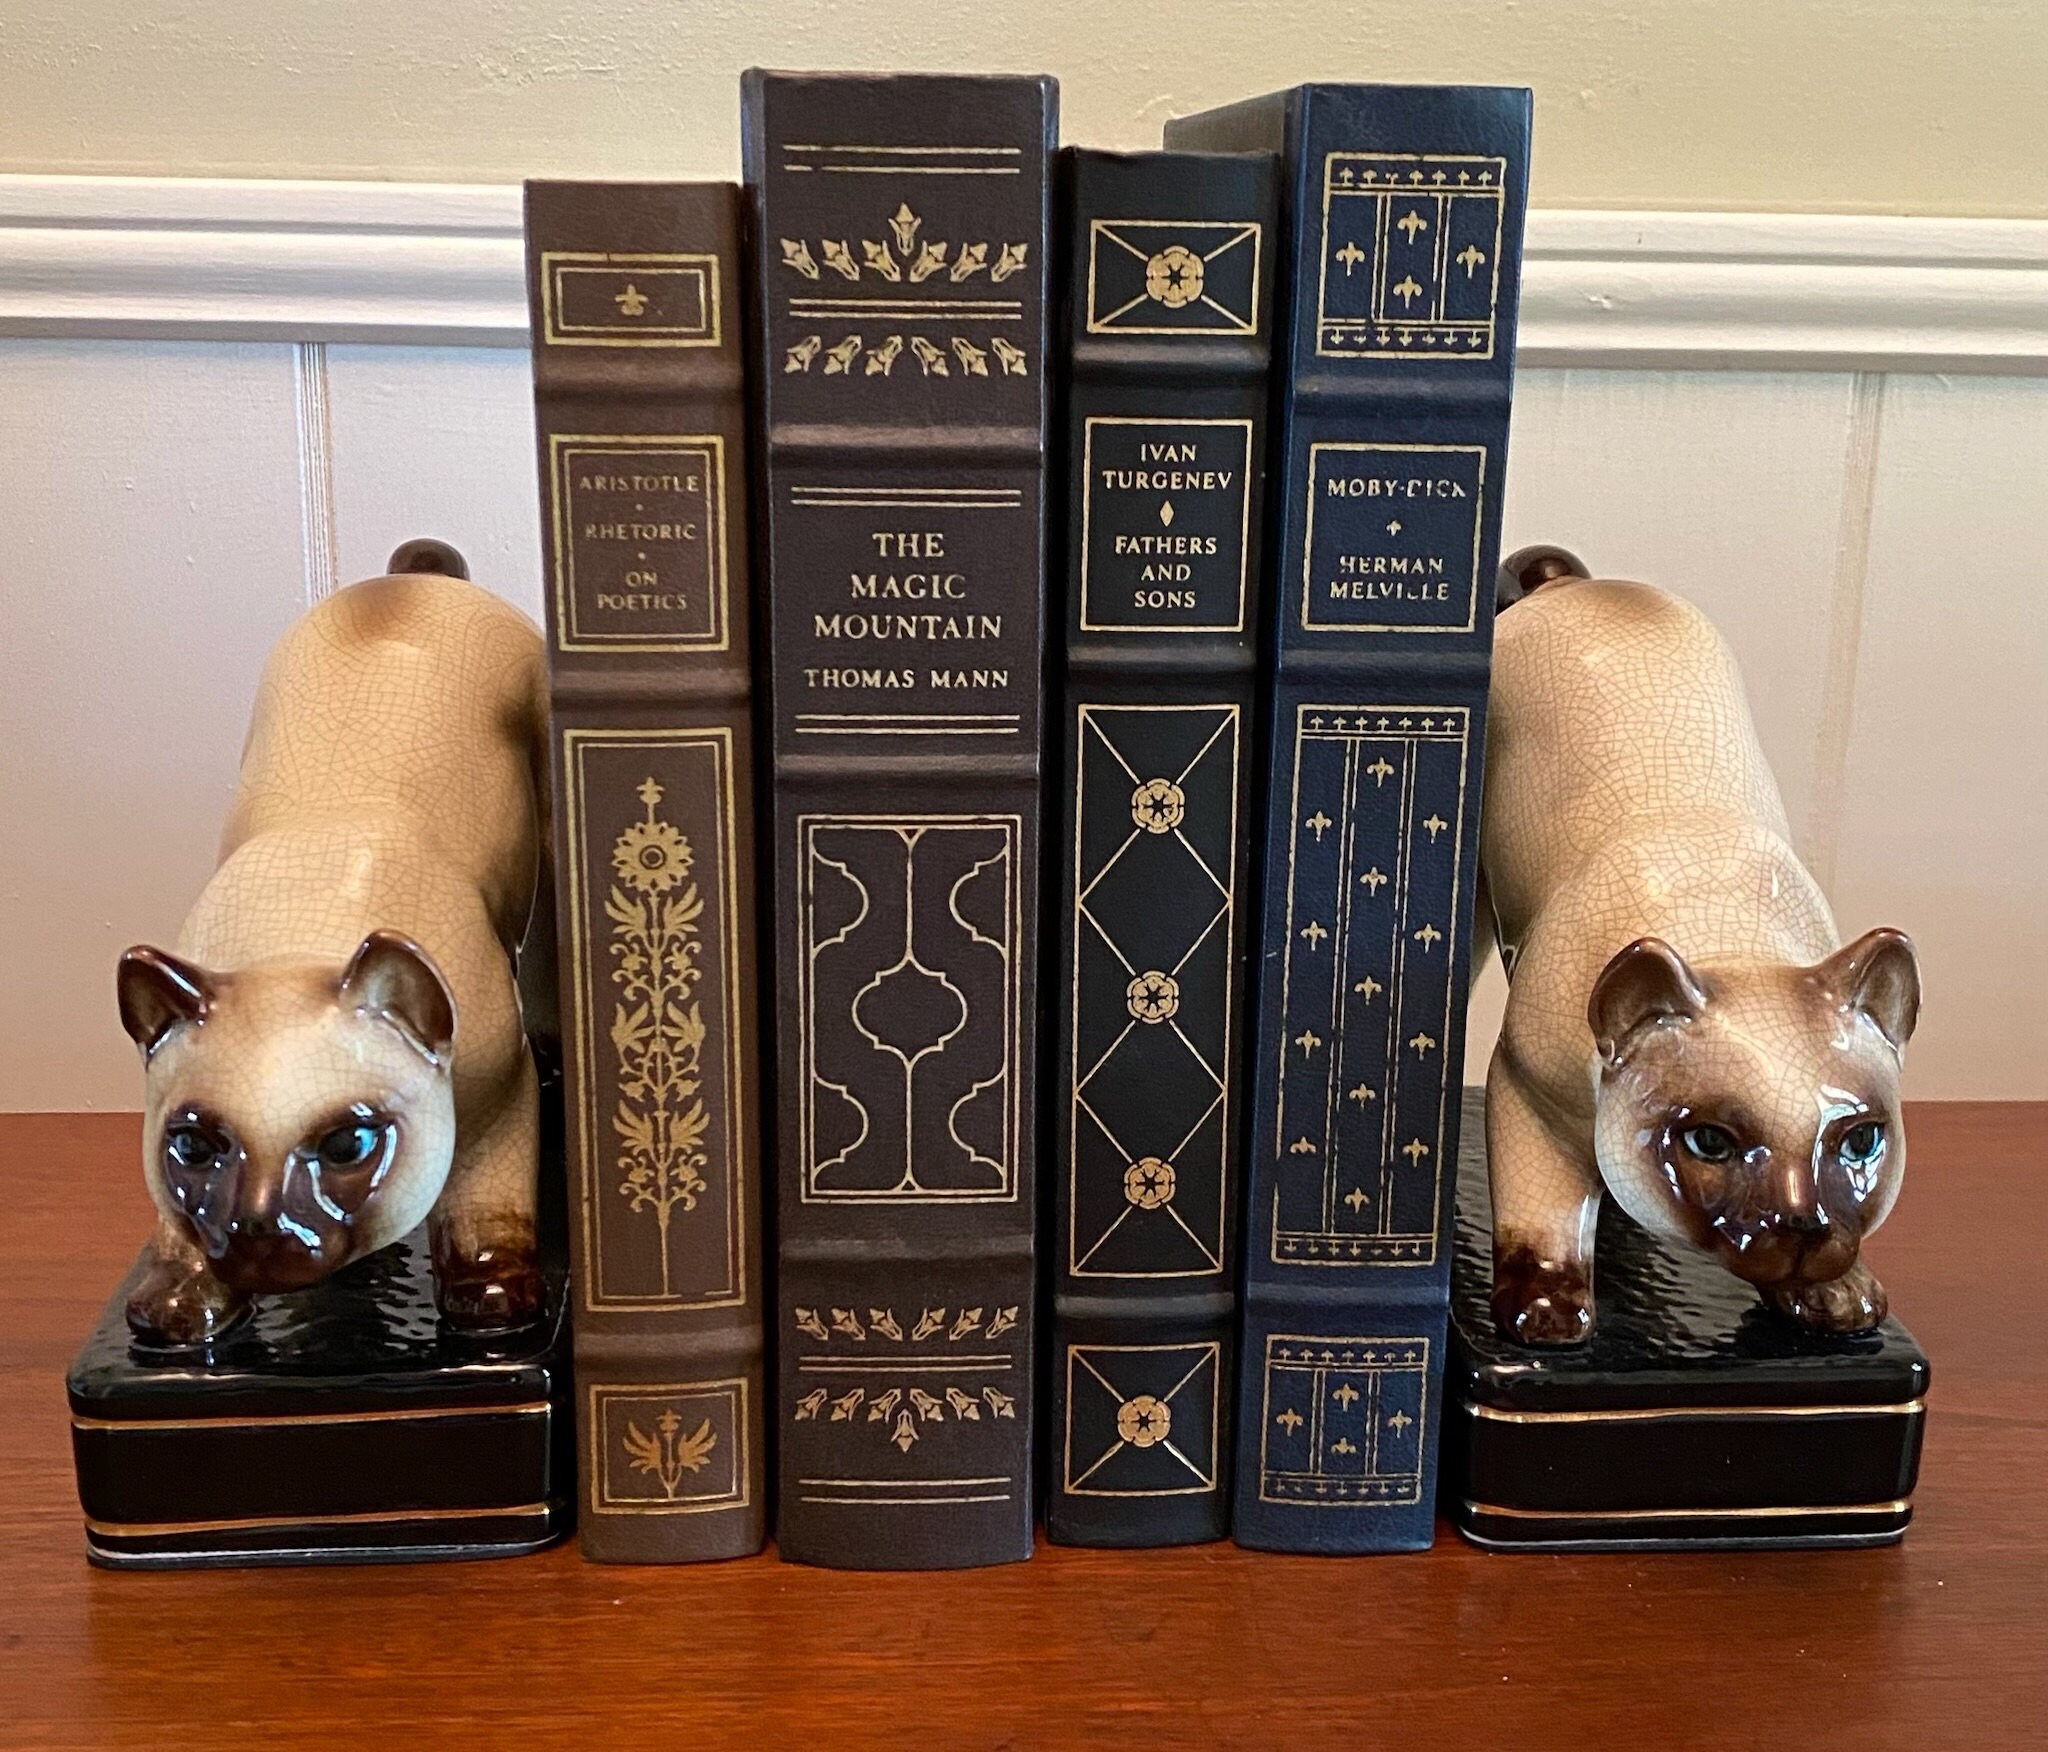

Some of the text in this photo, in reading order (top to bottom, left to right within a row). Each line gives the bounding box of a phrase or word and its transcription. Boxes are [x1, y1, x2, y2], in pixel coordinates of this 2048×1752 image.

[1140, 443, 1197, 462] IVAN
[579, 475, 700, 492] ARISTOTLE
[1102, 470, 1233, 490] TURGENEV
[585, 523, 697, 540] RHETORIC
[872, 533, 945, 558] THE
[1115, 535, 1217, 555] FATHERS
[1140, 564, 1191, 581] AND
[1339, 555, 1443, 574] HERMAN
[625, 571, 658, 587] ON
[850, 574, 966, 599] MAGIC
[597, 594, 687, 610] POETICS
[1134, 590, 1196, 608] SONS
[814, 614, 1002, 640] MOUNTAIN
[804, 669, 1009, 689] THOMAS MANN
